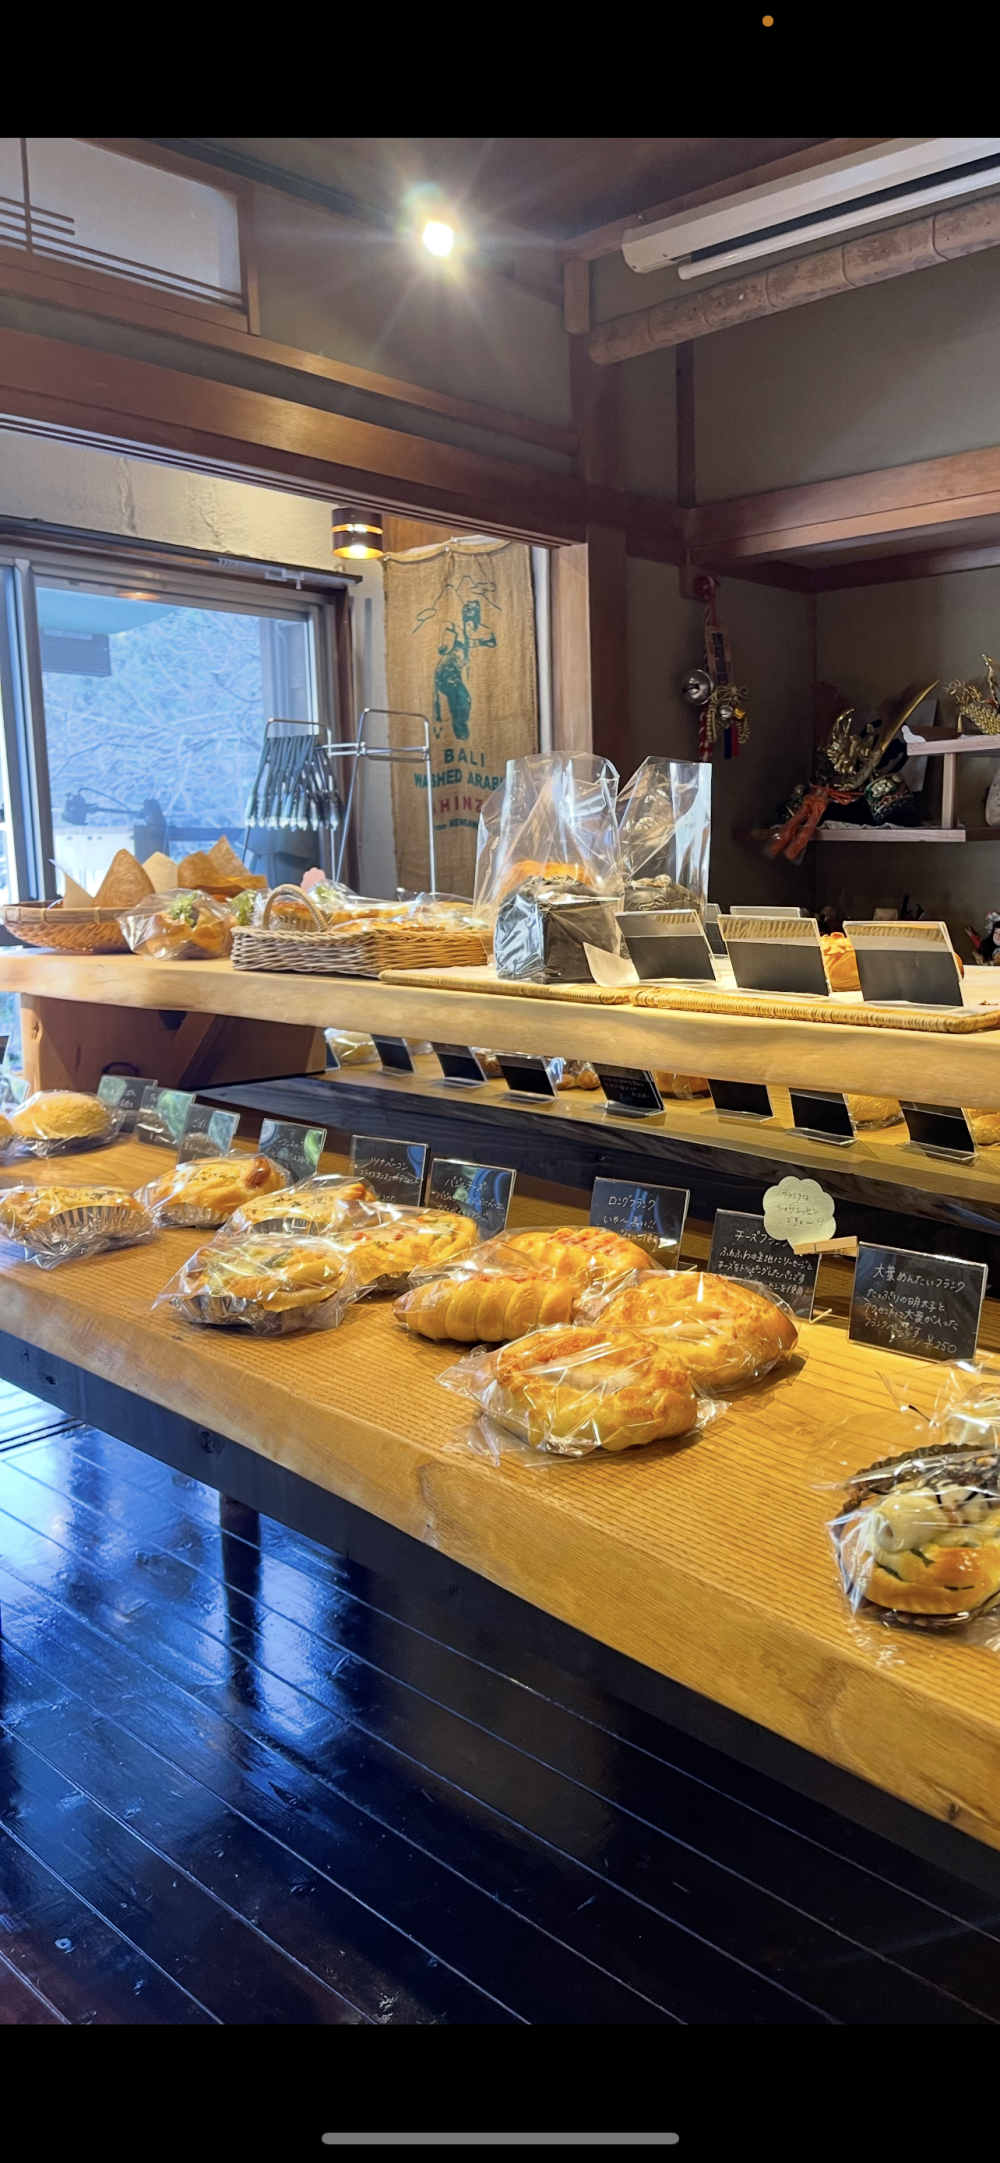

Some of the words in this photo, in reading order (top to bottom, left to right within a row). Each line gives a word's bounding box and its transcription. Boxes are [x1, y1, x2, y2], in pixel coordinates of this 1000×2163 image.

[444, 748, 485, 767] BALI
[444, 1175, 488, 1191] バジルチーズ
[608, 1194, 656, 1211] ロングフランク
[734, 1229, 789, 1248] チーズフラ
[872, 1262, 966, 1293] 大葉めんたいフランク
[866, 1288, 946, 1313] たっぷりの明太子と
